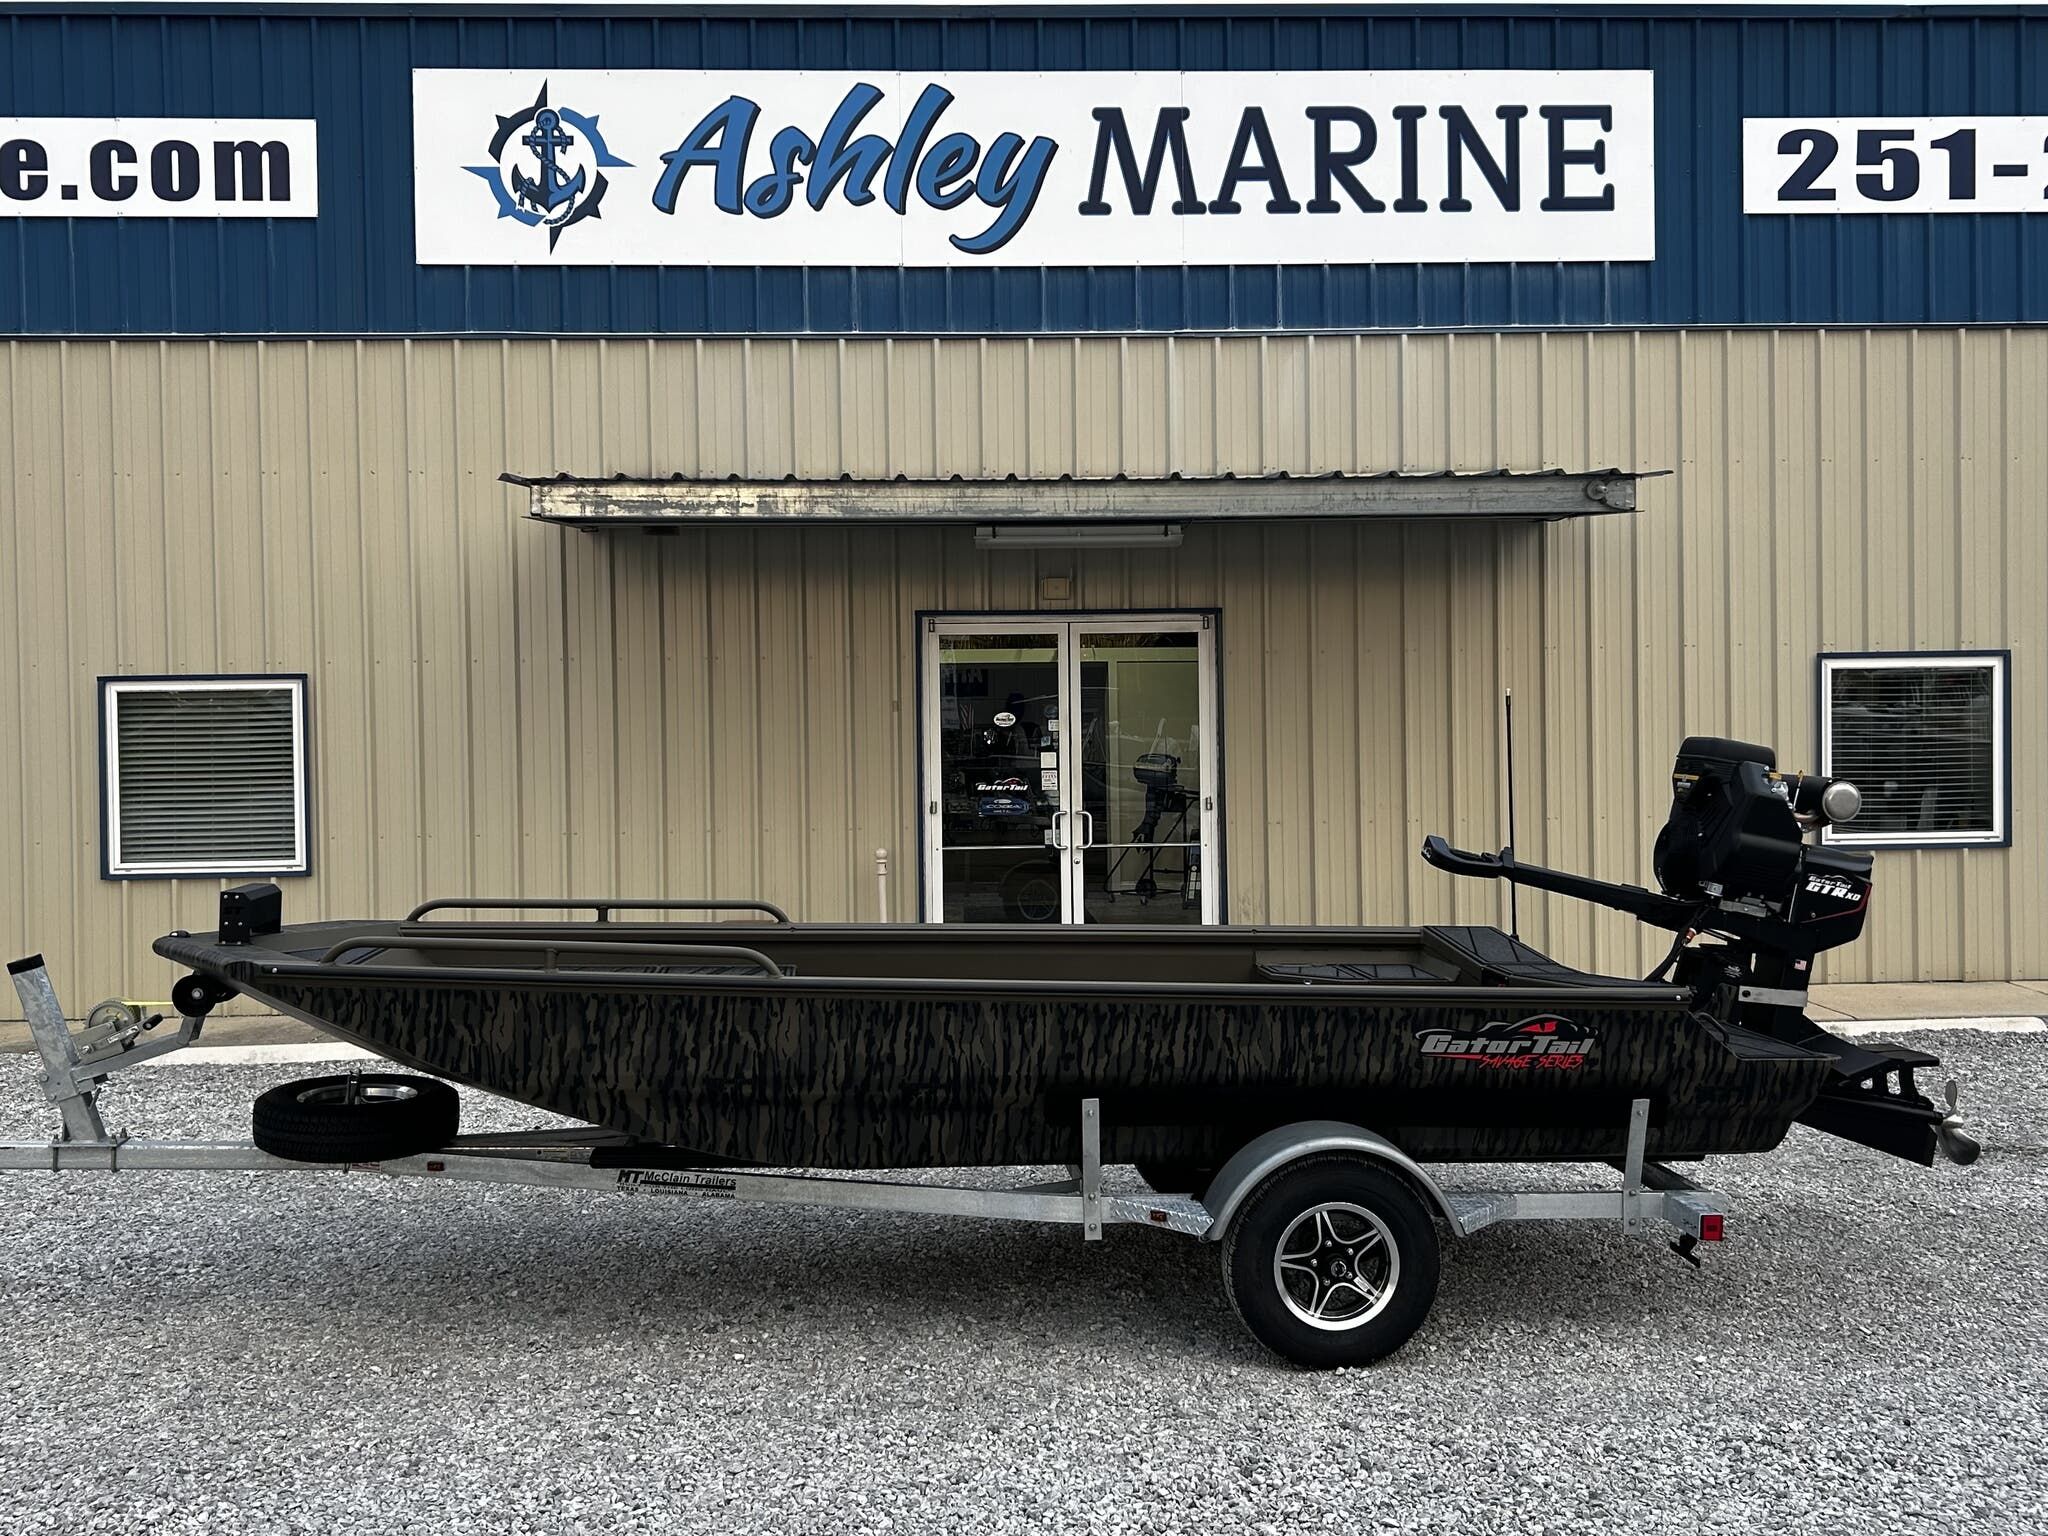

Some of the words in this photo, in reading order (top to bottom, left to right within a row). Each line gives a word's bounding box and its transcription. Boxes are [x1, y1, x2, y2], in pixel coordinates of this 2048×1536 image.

[0, 138, 291, 202] e.com
[652, 82, 1059, 255] Ashley
[1078, 104, 1615, 216] MARINE
[1777, 128, 2048, 201] 251-
[1420, 1034, 1595, 1054] GatorTail
[1479, 1054, 1532, 1069] SAVAGE
[1536, 1054, 1584, 1069] SERIES
[644, 1171, 691, 1183] McClain
[694, 1174, 737, 1187] Trailers
[650, 1188, 688, 1196] LOUISIANA
